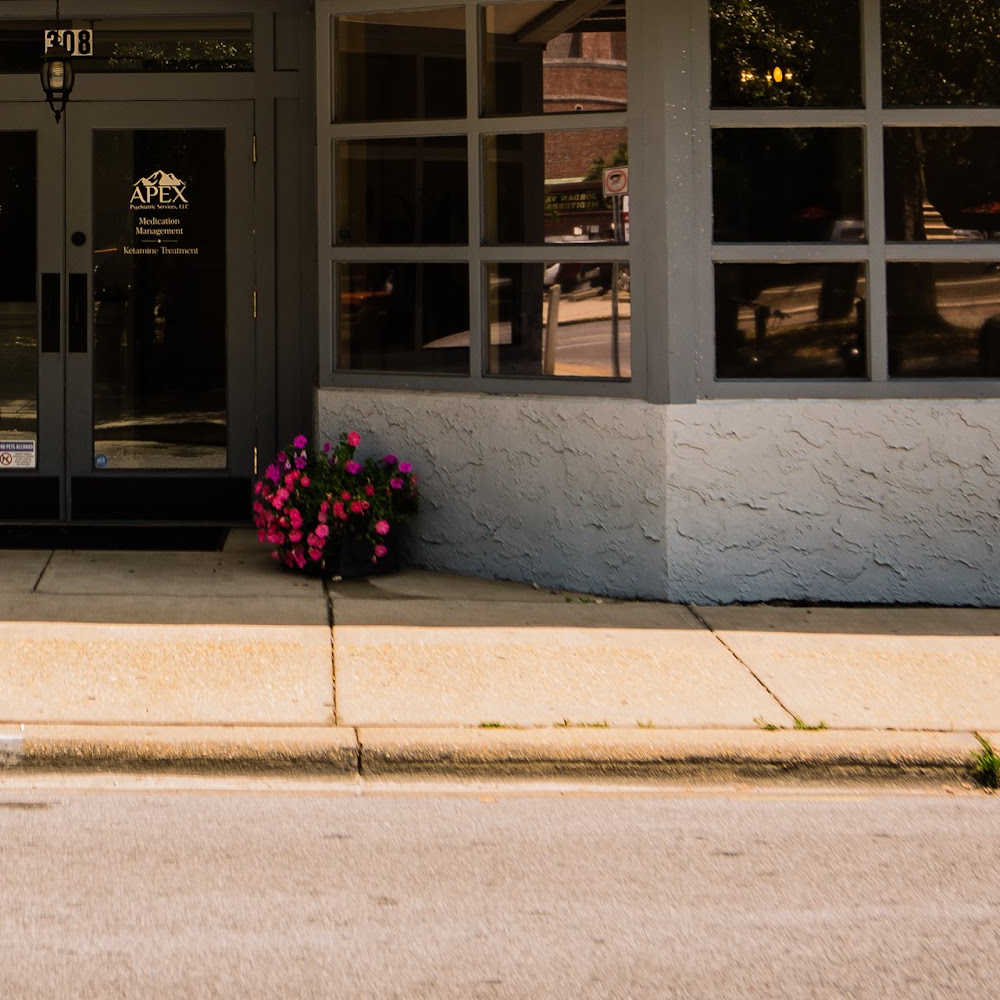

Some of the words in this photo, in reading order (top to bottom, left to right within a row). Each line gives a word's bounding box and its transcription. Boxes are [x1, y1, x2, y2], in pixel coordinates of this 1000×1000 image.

[130, 186, 189, 203] APEX
[139, 217, 180, 225] Medication
[136, 227, 183, 236] Management
[123, 246, 158, 254] Ketamine
[160, 246, 199, 254] Treatment
